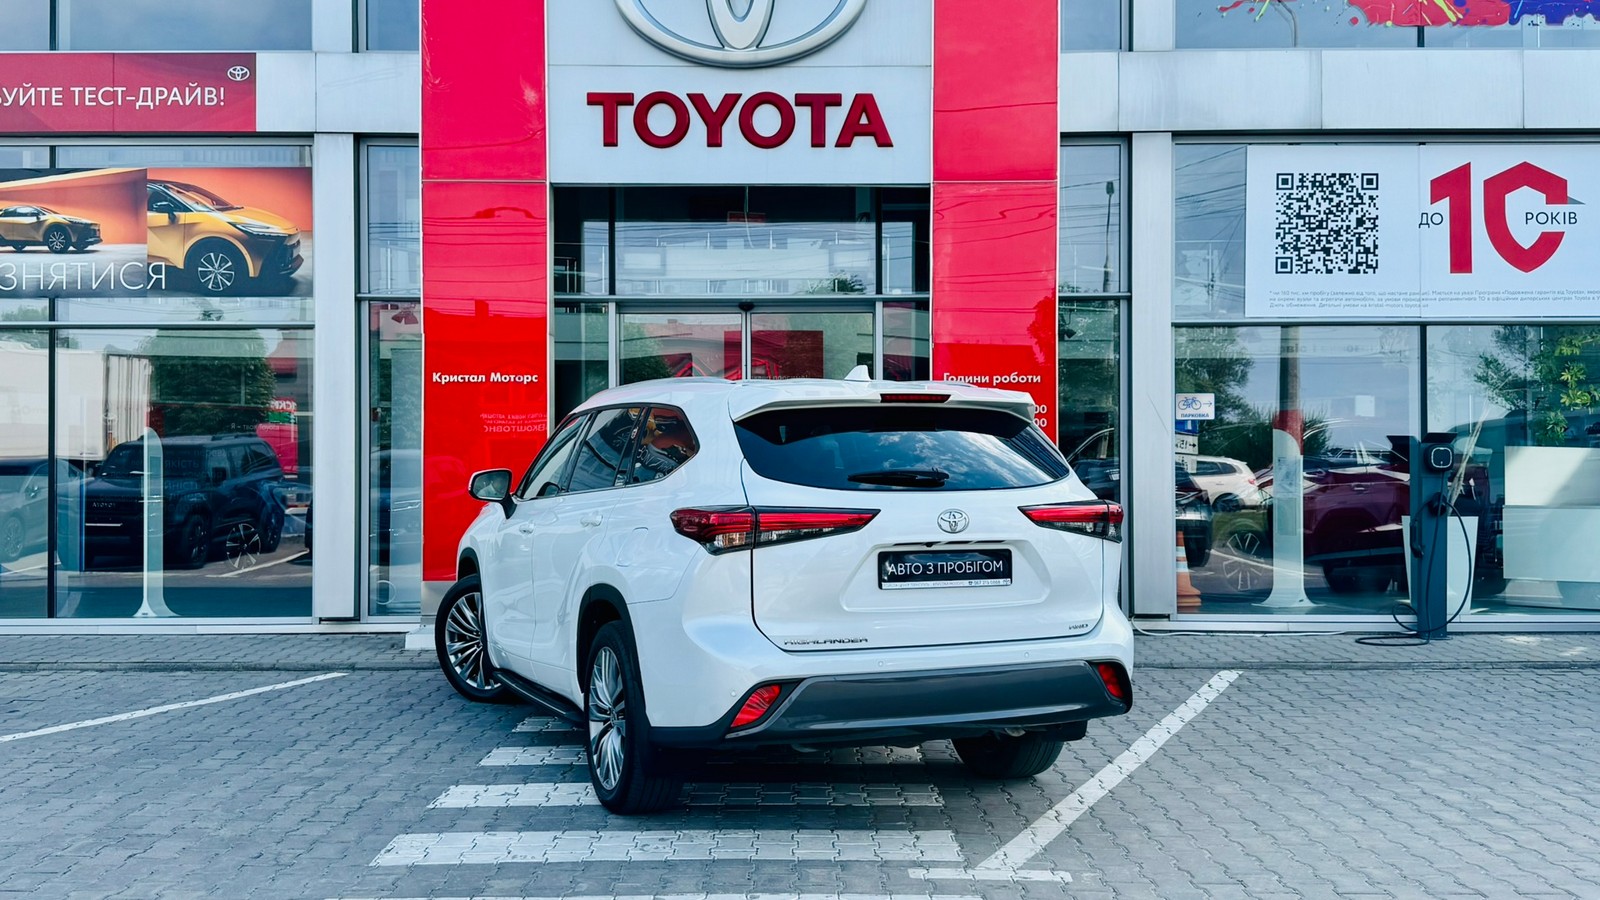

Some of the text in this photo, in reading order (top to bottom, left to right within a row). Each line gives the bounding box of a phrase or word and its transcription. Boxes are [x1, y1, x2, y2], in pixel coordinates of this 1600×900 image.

[0, 82, 225, 110] УЙТЕ ТЕСТ-ДРАЙВ!
[587, 91, 894, 149] TOYOTA
[1418, 212, 1443, 229] ДО
[1525, 211, 1578, 225] РОКІВ
[432, 372, 538, 385] Кристал Моторс
[993, 372, 1041, 386] роботи
[888, 560, 1003, 576] АВТО З ПРОБІГОМ
[783, 636, 868, 646] HIGHLANDER
